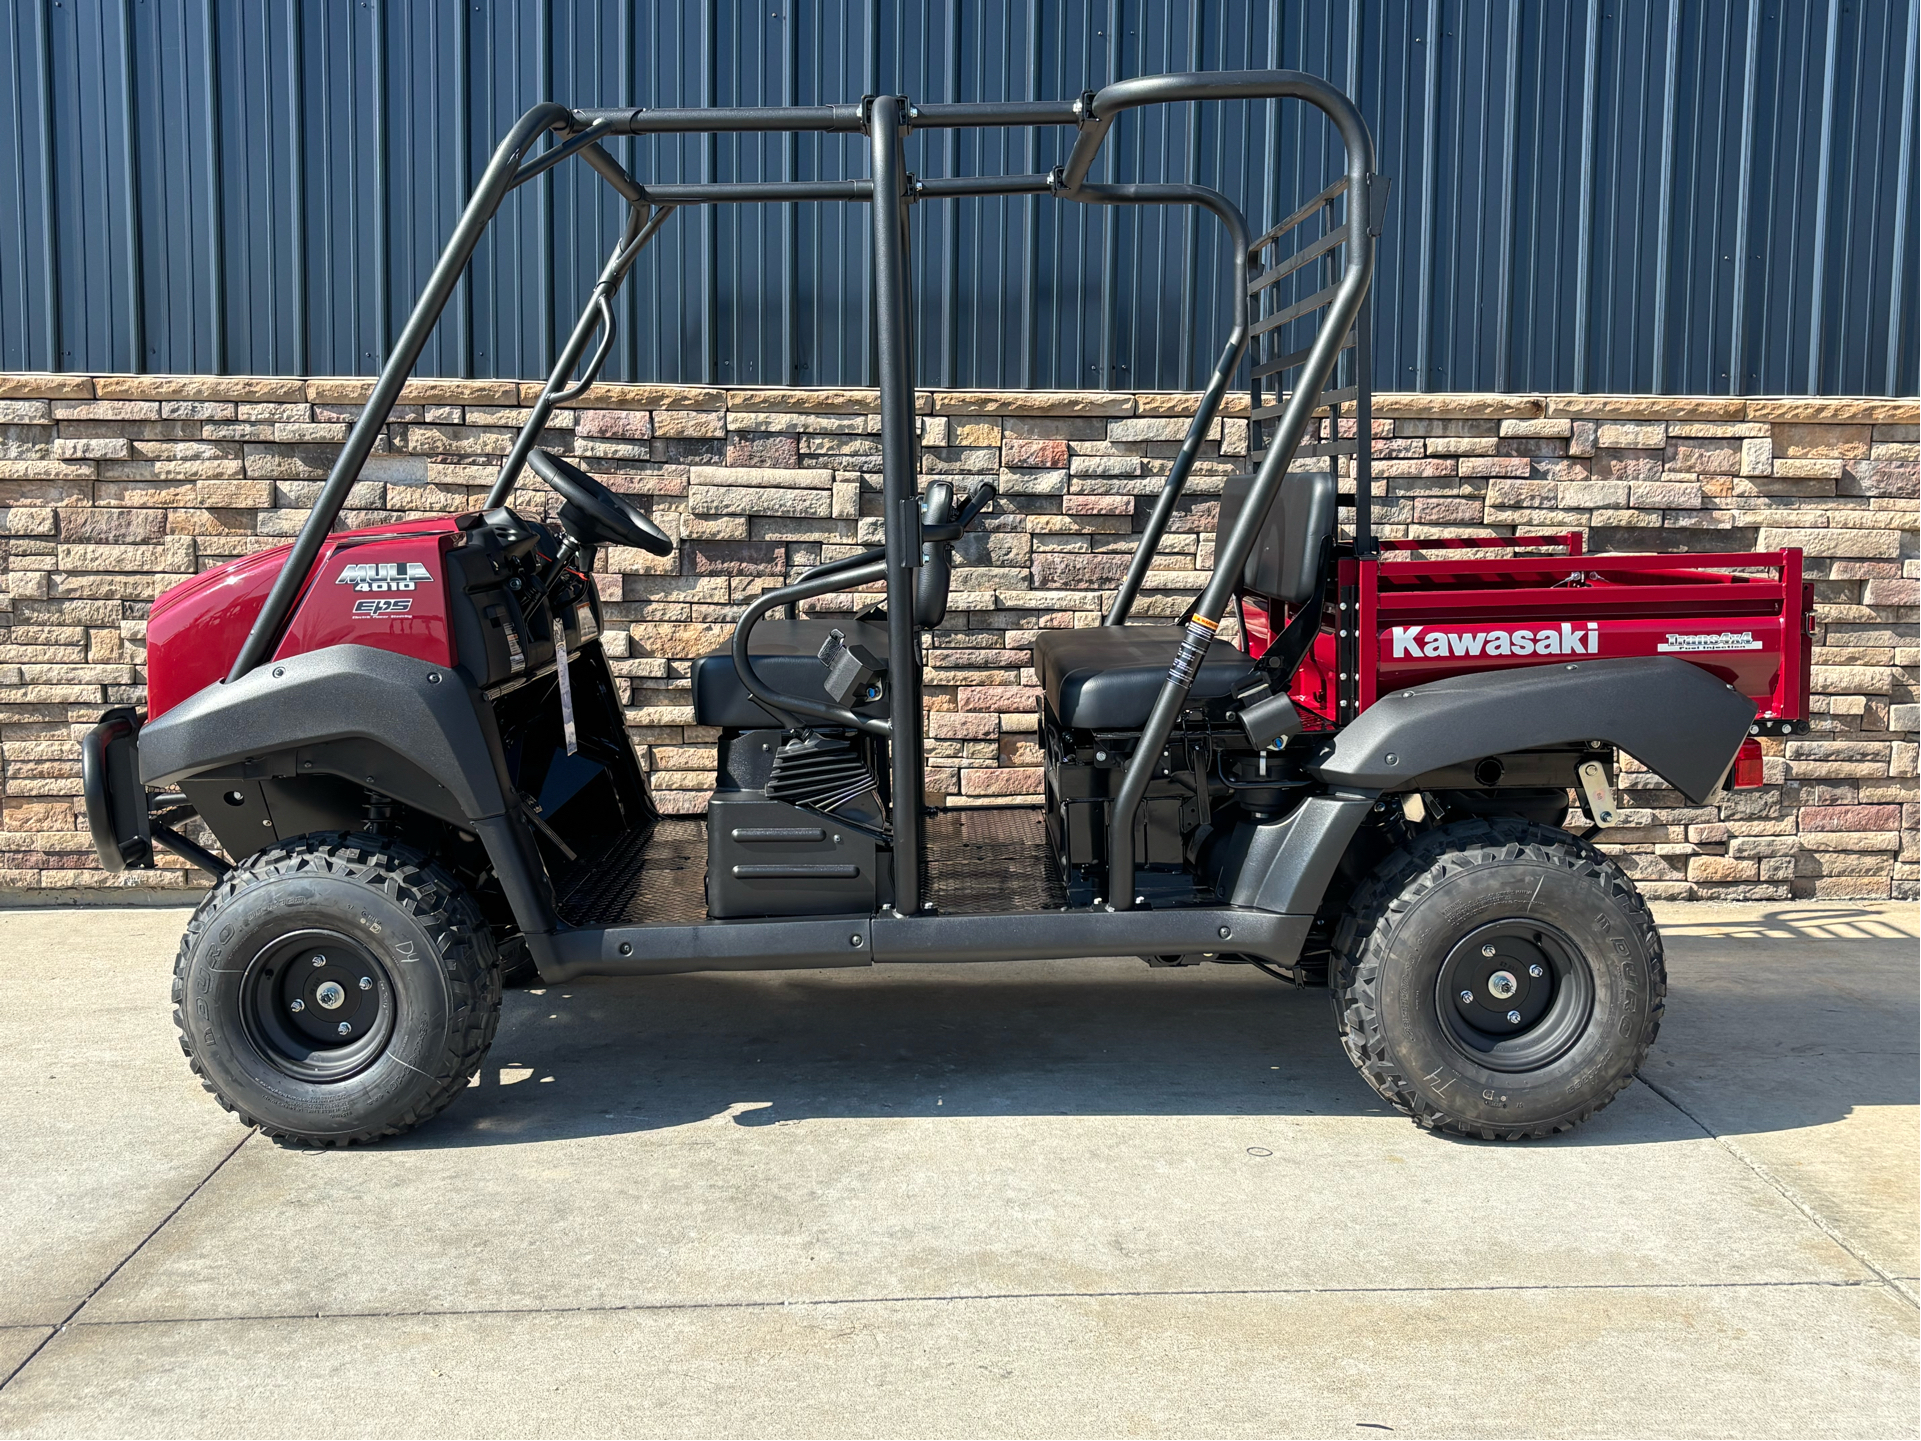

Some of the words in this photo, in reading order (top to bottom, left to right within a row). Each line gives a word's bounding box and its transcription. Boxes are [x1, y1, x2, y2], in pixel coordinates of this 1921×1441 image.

[335, 563, 434, 584] MULE
[355, 582, 415, 591] 4010
[1392, 622, 1598, 658] Kawasaki
[196, 923, 236, 1021] DURO
[1610, 937, 1639, 1038] DURO
